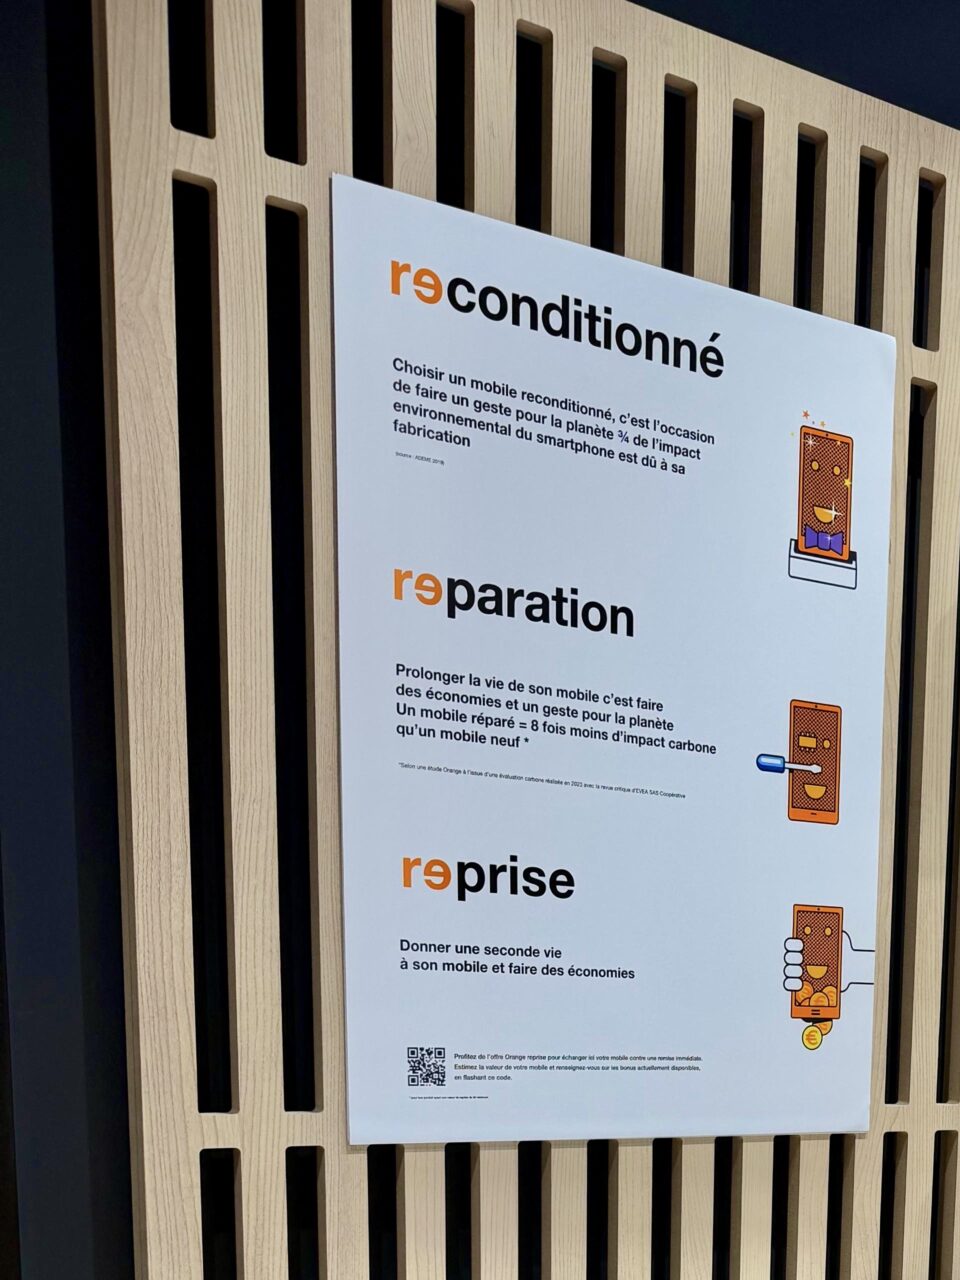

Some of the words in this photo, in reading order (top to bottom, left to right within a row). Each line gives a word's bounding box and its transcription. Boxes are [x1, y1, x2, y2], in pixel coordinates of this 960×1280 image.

[390, 259, 725, 379] reconditionné
[393, 358, 444, 381] Choisir
[449, 374, 466, 386] un
[471, 379, 517, 398] mobile
[522, 391, 615, 423] reconditionné,
[620, 413, 650, 430] c'est
[654, 420, 714, 444] l'occasion
[393, 379, 410, 394] de
[415, 384, 447, 402] faire
[452, 394, 469, 407] un
[474, 400, 512, 416] geste
[516, 410, 547, 424] pour
[551, 414, 562, 428] la
[566, 420, 614, 440] planète
[633, 434, 648, 448] de
[652, 438, 700, 460] l'impact
[393, 419, 470, 447] fabrication
[394, 402, 511, 436] environnemental
[516, 427, 532, 440] du
[537, 434, 614, 458] smartphone
[619, 452, 638, 464] est
[642, 455, 656, 468] dû
[660, 458, 667, 470] à
[672, 464, 685, 474] sa
[393, 568, 634, 637] reparation
[396, 664, 465, 685] Prolonger
[469, 674, 480, 686] la
[485, 677, 504, 689] vie
[508, 680, 524, 692] de
[529, 685, 552, 696] son
[557, 688, 599, 702] mobile
[603, 694, 633, 708] c'est
[636, 697, 663, 712] faire
[396, 684, 421, 698] des
[426, 687, 501, 708] économies
[506, 699, 518, 710] et
[523, 702, 538, 713] un
[543, 705, 578, 718] geste
[582, 710, 611, 722] pour
[615, 712, 625, 724] la
[630, 715, 674, 731] planète
[396, 724, 435, 738] qu'un
[440, 730, 486, 744] mobile
[491, 736, 520, 748] neuf
[397, 702, 415, 716] Un
[421, 708, 467, 722] mobile
[472, 712, 515, 728] réparé
[531, 720, 538, 731] 8
[542, 721, 566, 735] fois
[570, 727, 608, 740] moins
[612, 730, 665, 748] d'impact
[668, 740, 716, 754] carbone
[401, 854, 576, 902] reprise
[400, 939, 451, 953] Donner
[455, 945, 480, 954] une
[484, 946, 540, 957] seconde
[544, 947, 562, 958] vie
[400, 958, 408, 969] à
[413, 961, 438, 970] son
[442, 960, 488, 972] mobile
[492, 963, 504, 973] et
[508, 962, 537, 974] faire
[541, 964, 564, 976] des
[568, 965, 634, 978] économies
